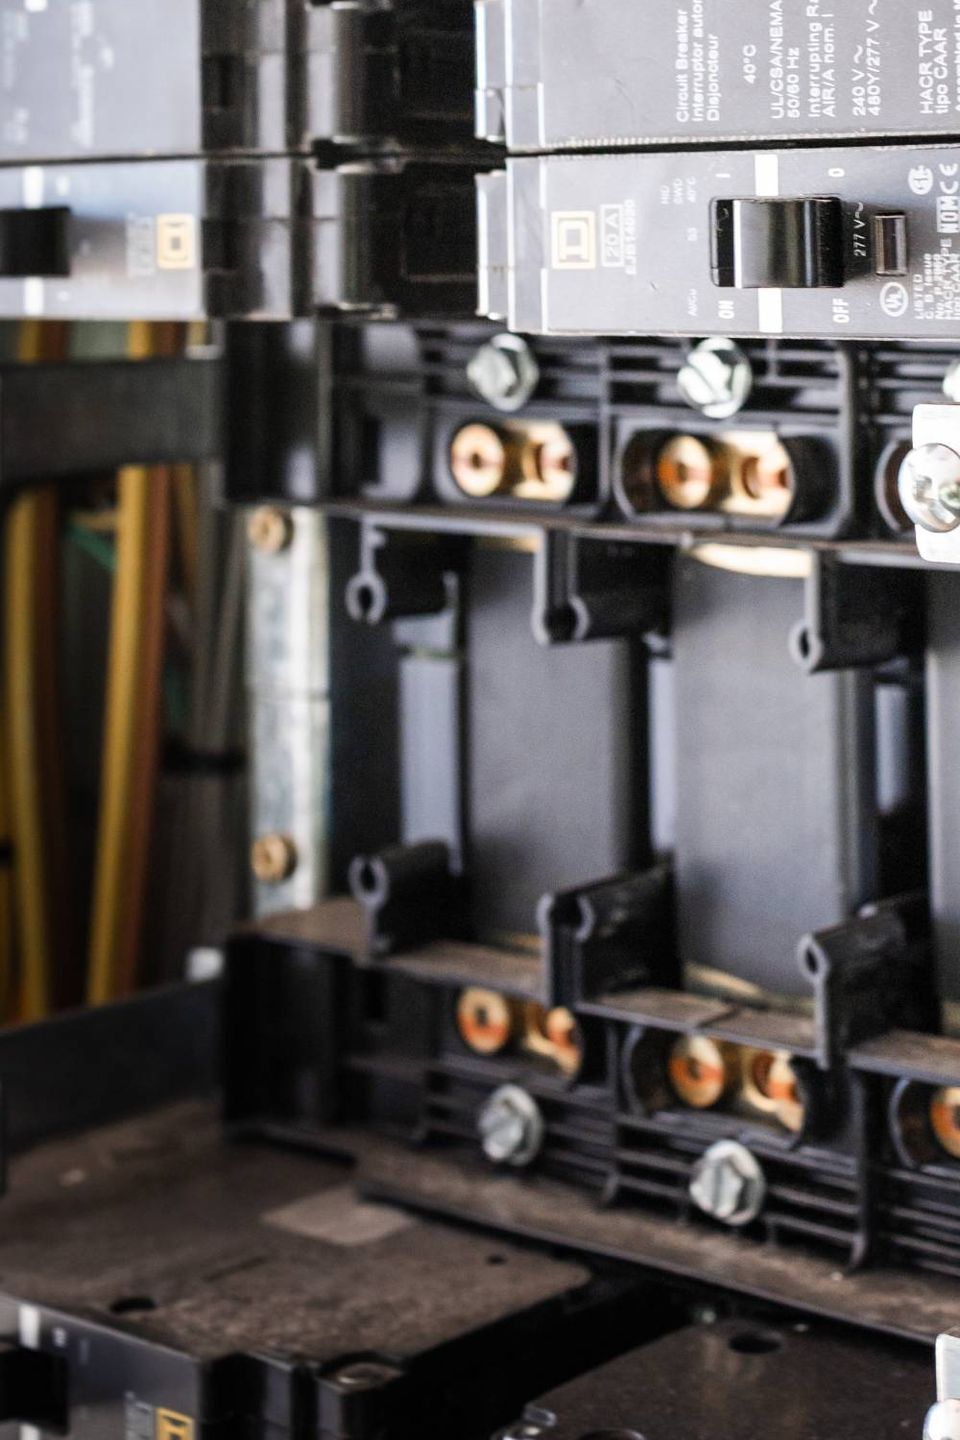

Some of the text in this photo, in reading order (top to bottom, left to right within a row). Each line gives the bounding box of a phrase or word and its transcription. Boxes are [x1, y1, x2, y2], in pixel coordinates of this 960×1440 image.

[676, 9, 689, 122] Circuit Breaker
[691, 42, 705, 122] Interruptor
[707, 33, 722, 121] Disjoncteur
[743, 44, 757, 84] 40°C
[770, 0, 784, 119] UL/CSA/NEMA
[786, 47, 800, 118] 50/60 Hz
[807, 23, 823, 117] Interrupting
[822, 22, 836, 117] AIR/A nom.
[852, 69, 866, 116] 240 V
[867, 38, 881, 116] 480Y/277
[918, 10, 933, 114] HACR TYPE
[934, 28, 951, 114] tipo CAAR
[605, 213, 619, 258] 20 A
[854, 219, 867, 257] 277 V
[940, 196, 958, 233] NOM
[940, 238, 952, 275] TYPE
[718, 300, 734, 319] ON
[832, 298, 849, 323] OFF
[913, 274, 923, 320] LISTED
